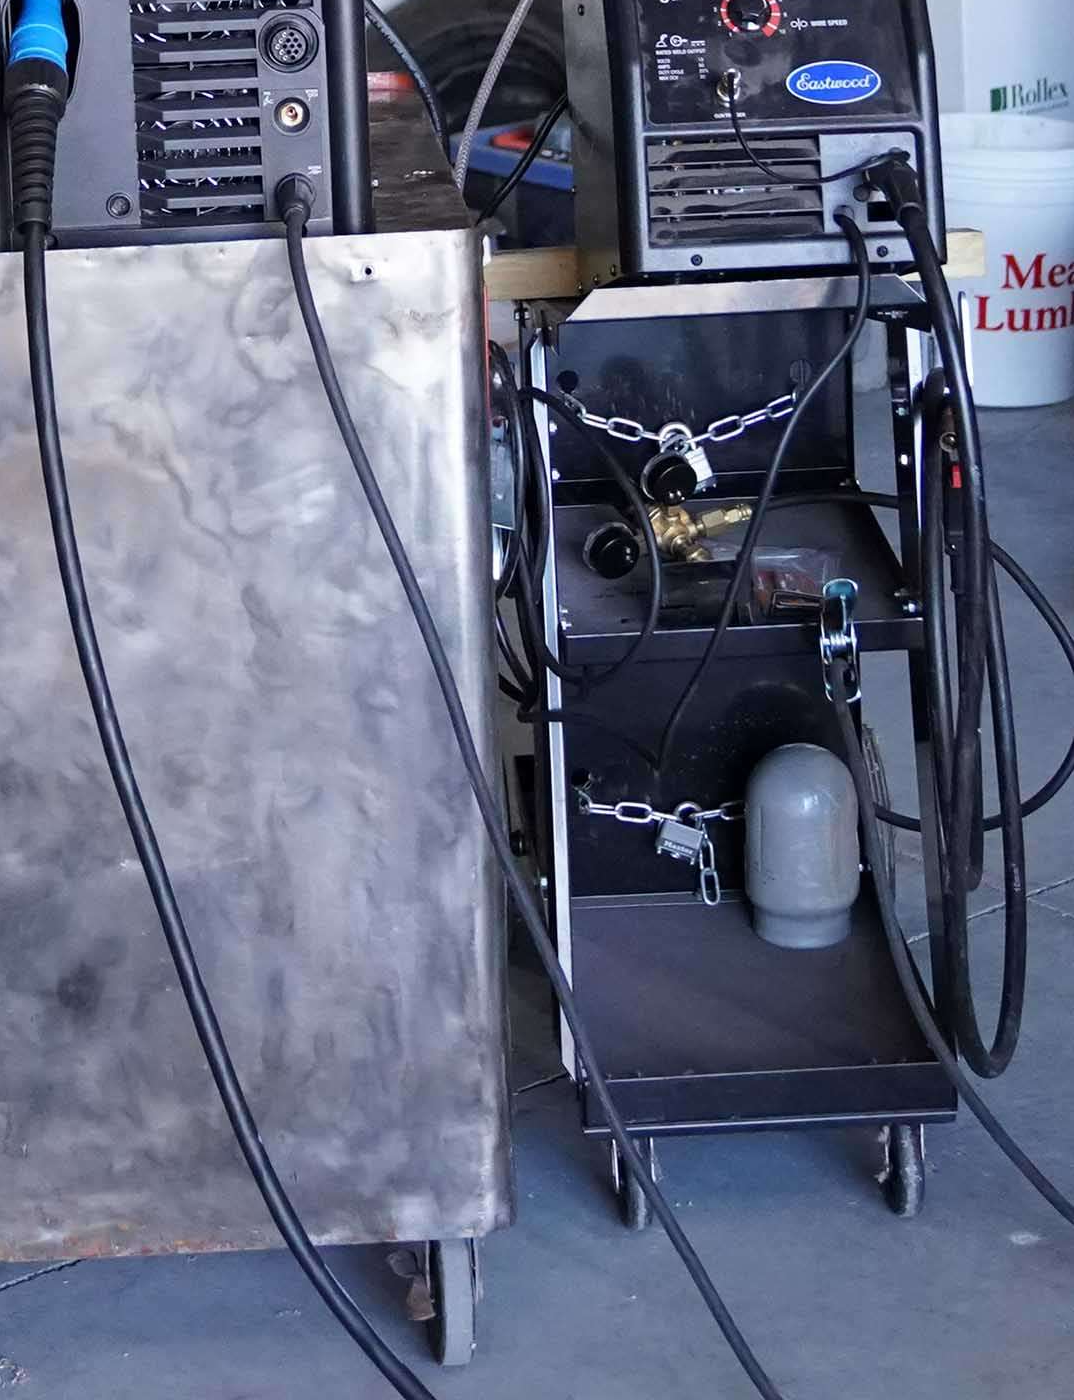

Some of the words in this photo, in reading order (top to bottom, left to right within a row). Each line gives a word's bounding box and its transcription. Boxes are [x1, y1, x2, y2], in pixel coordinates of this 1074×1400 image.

[796, 72, 871, 91] Eastwood
[1011, 77, 1069, 108] Rollex
[974, 290, 1074, 332] Lum
